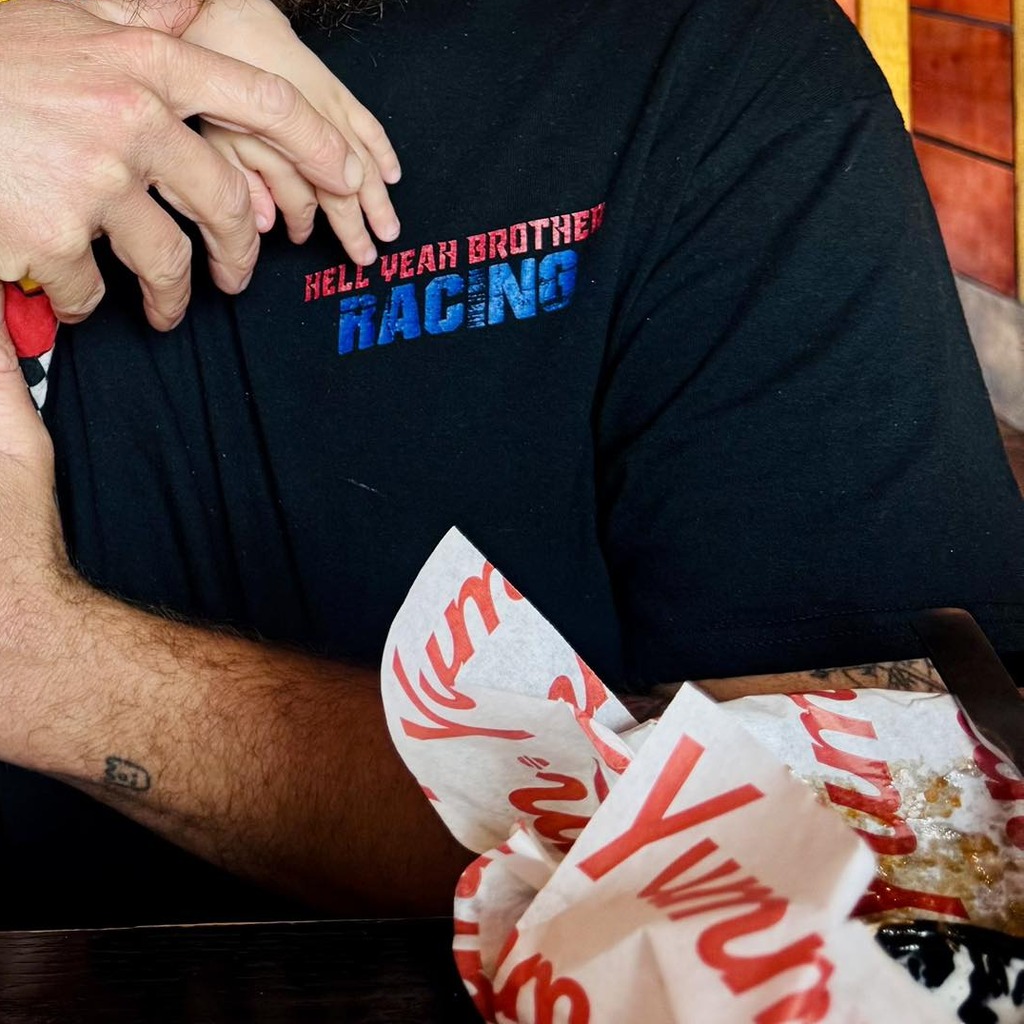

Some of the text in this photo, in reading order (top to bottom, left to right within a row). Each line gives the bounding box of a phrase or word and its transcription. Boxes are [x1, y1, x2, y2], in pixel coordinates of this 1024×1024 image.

[304, 202, 606, 302] HELL YEAH BROTHER
[337, 249, 580, 356] RACING
